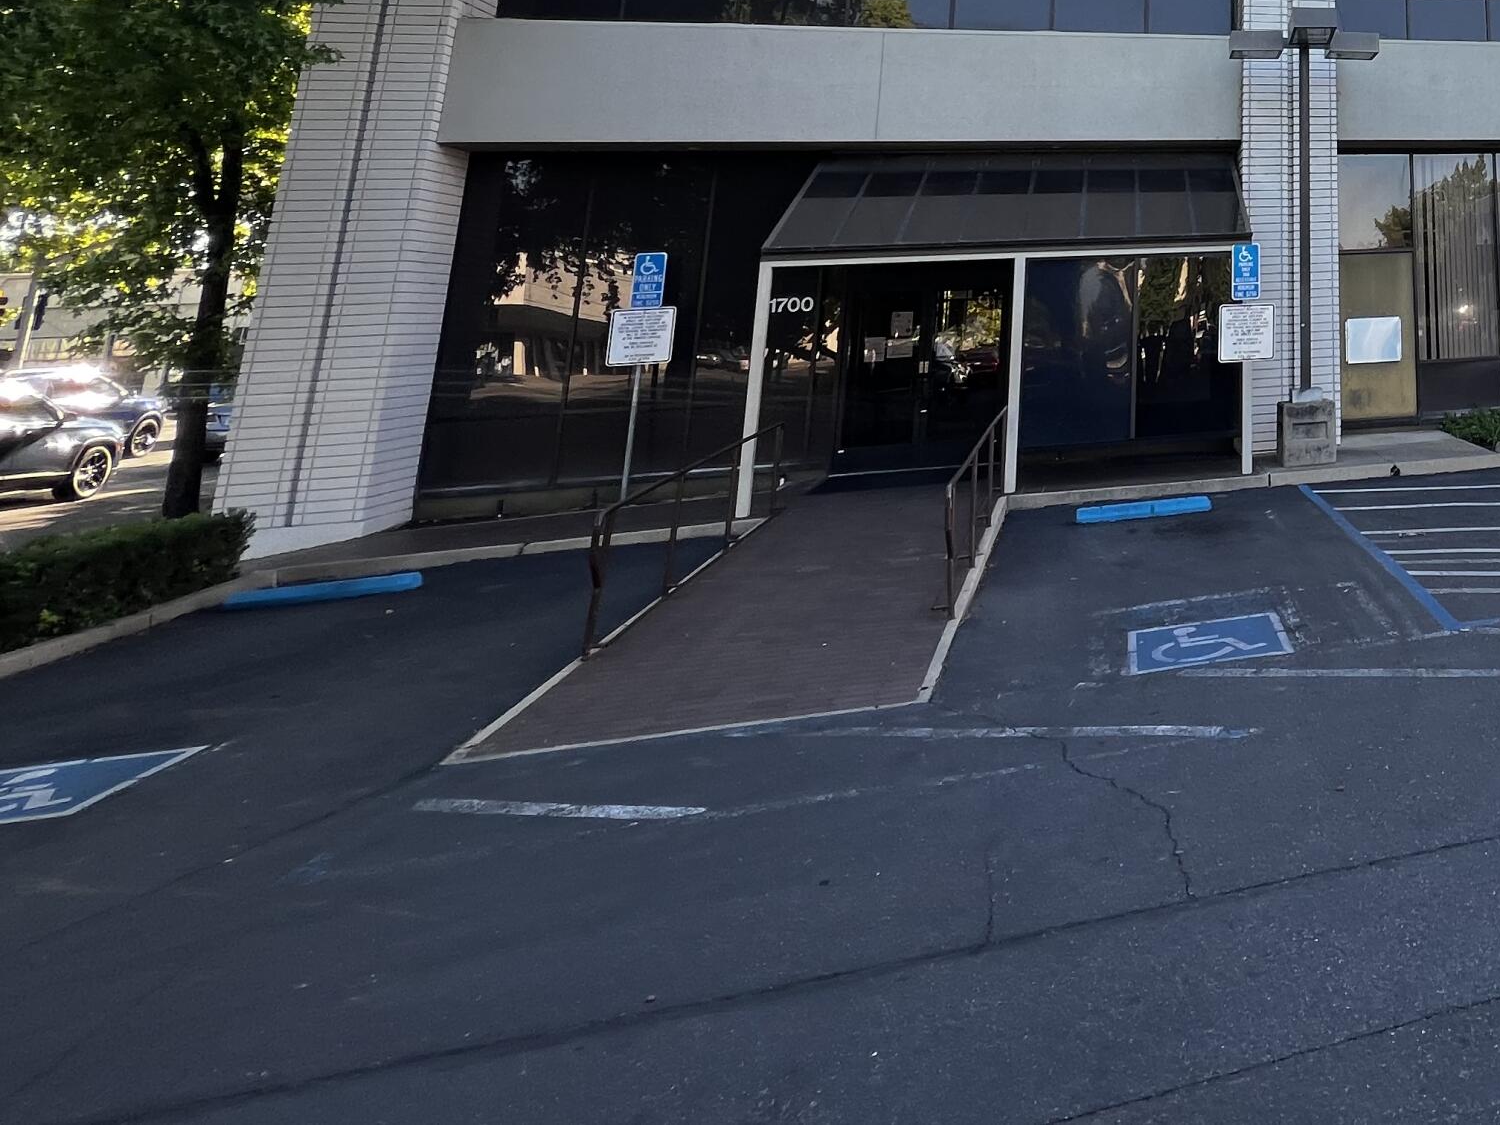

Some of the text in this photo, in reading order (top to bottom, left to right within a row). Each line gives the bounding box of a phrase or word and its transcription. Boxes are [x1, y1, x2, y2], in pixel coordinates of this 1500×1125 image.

[634, 274, 663, 283] PARKING
[639, 283, 657, 292] ONLY
[769, 296, 814, 313] 1700
